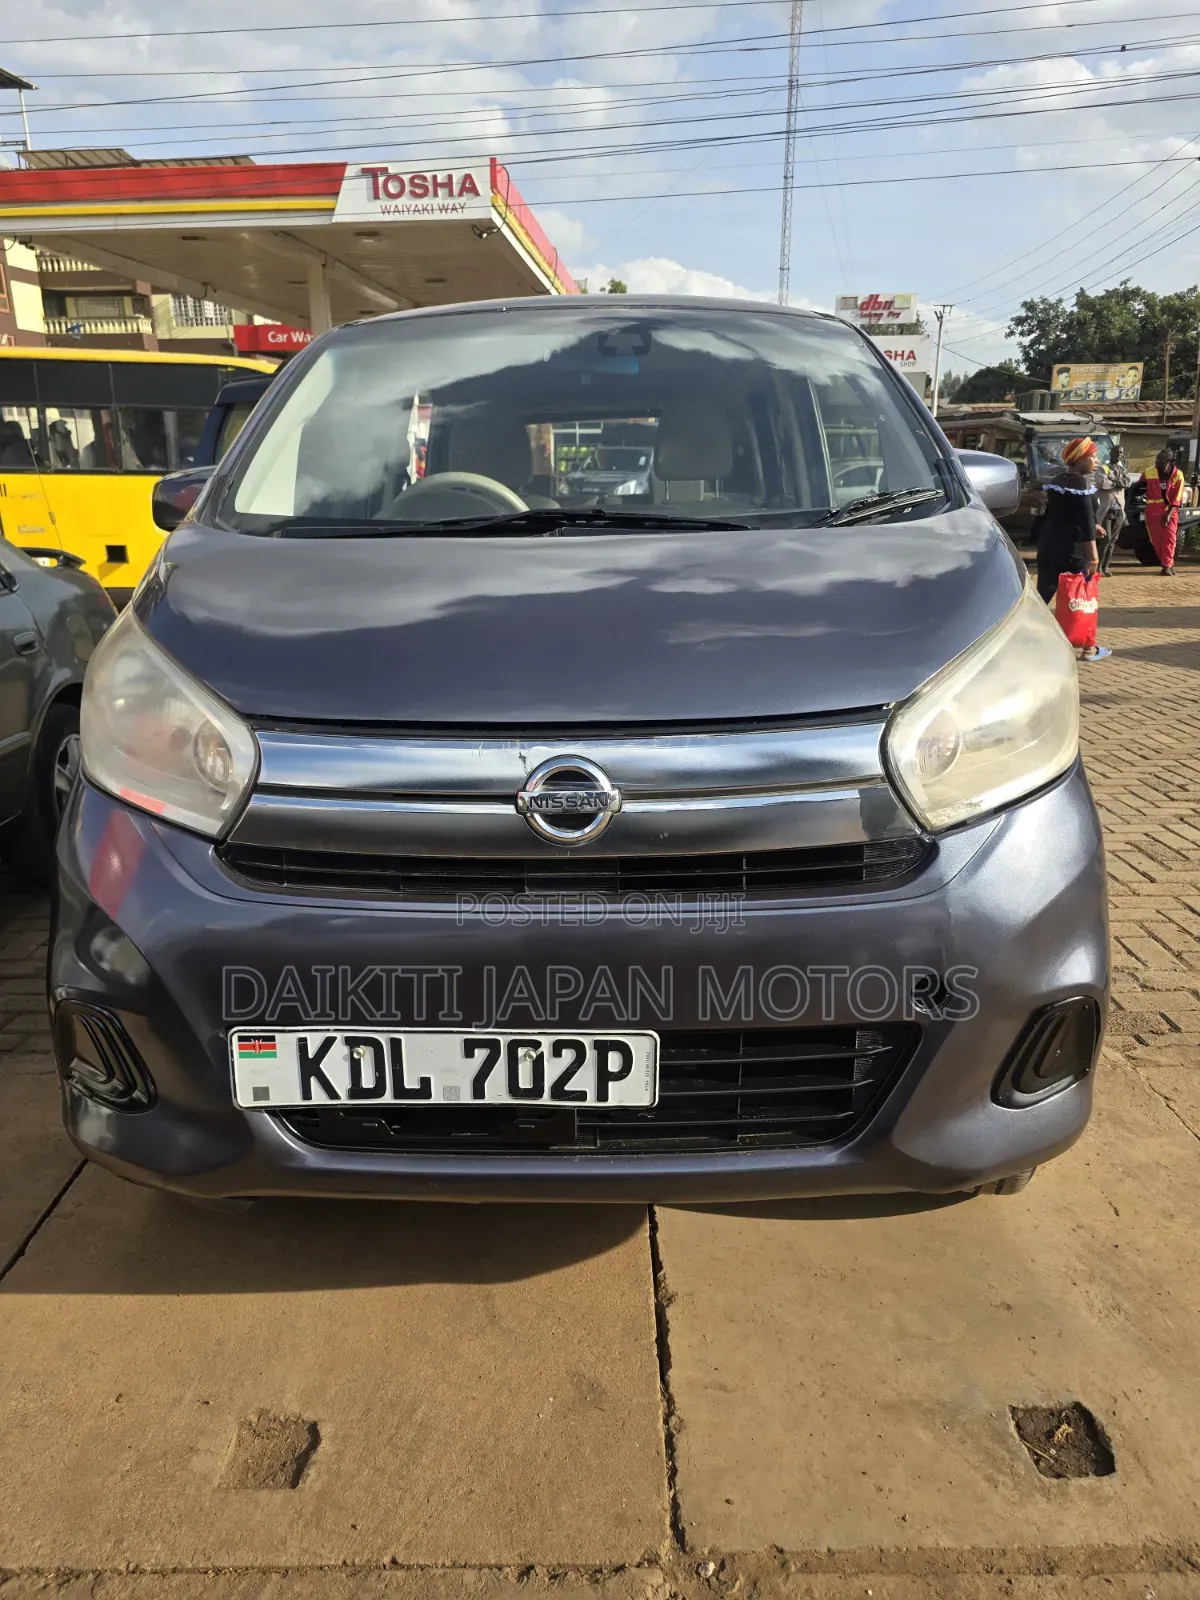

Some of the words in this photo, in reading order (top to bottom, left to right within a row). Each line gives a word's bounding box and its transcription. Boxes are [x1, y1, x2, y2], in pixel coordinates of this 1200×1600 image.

[361, 166, 481, 200] TOSHA
[380, 203, 434, 216] WAIYAKI
[438, 202, 467, 214] WAY
[267, 331, 288, 343] Car
[290, 331, 314, 343] Wa
[529, 795, 608, 808] NISSAN
[298, 1035, 433, 1101] KDL
[463, 1037, 634, 1102] 702P
